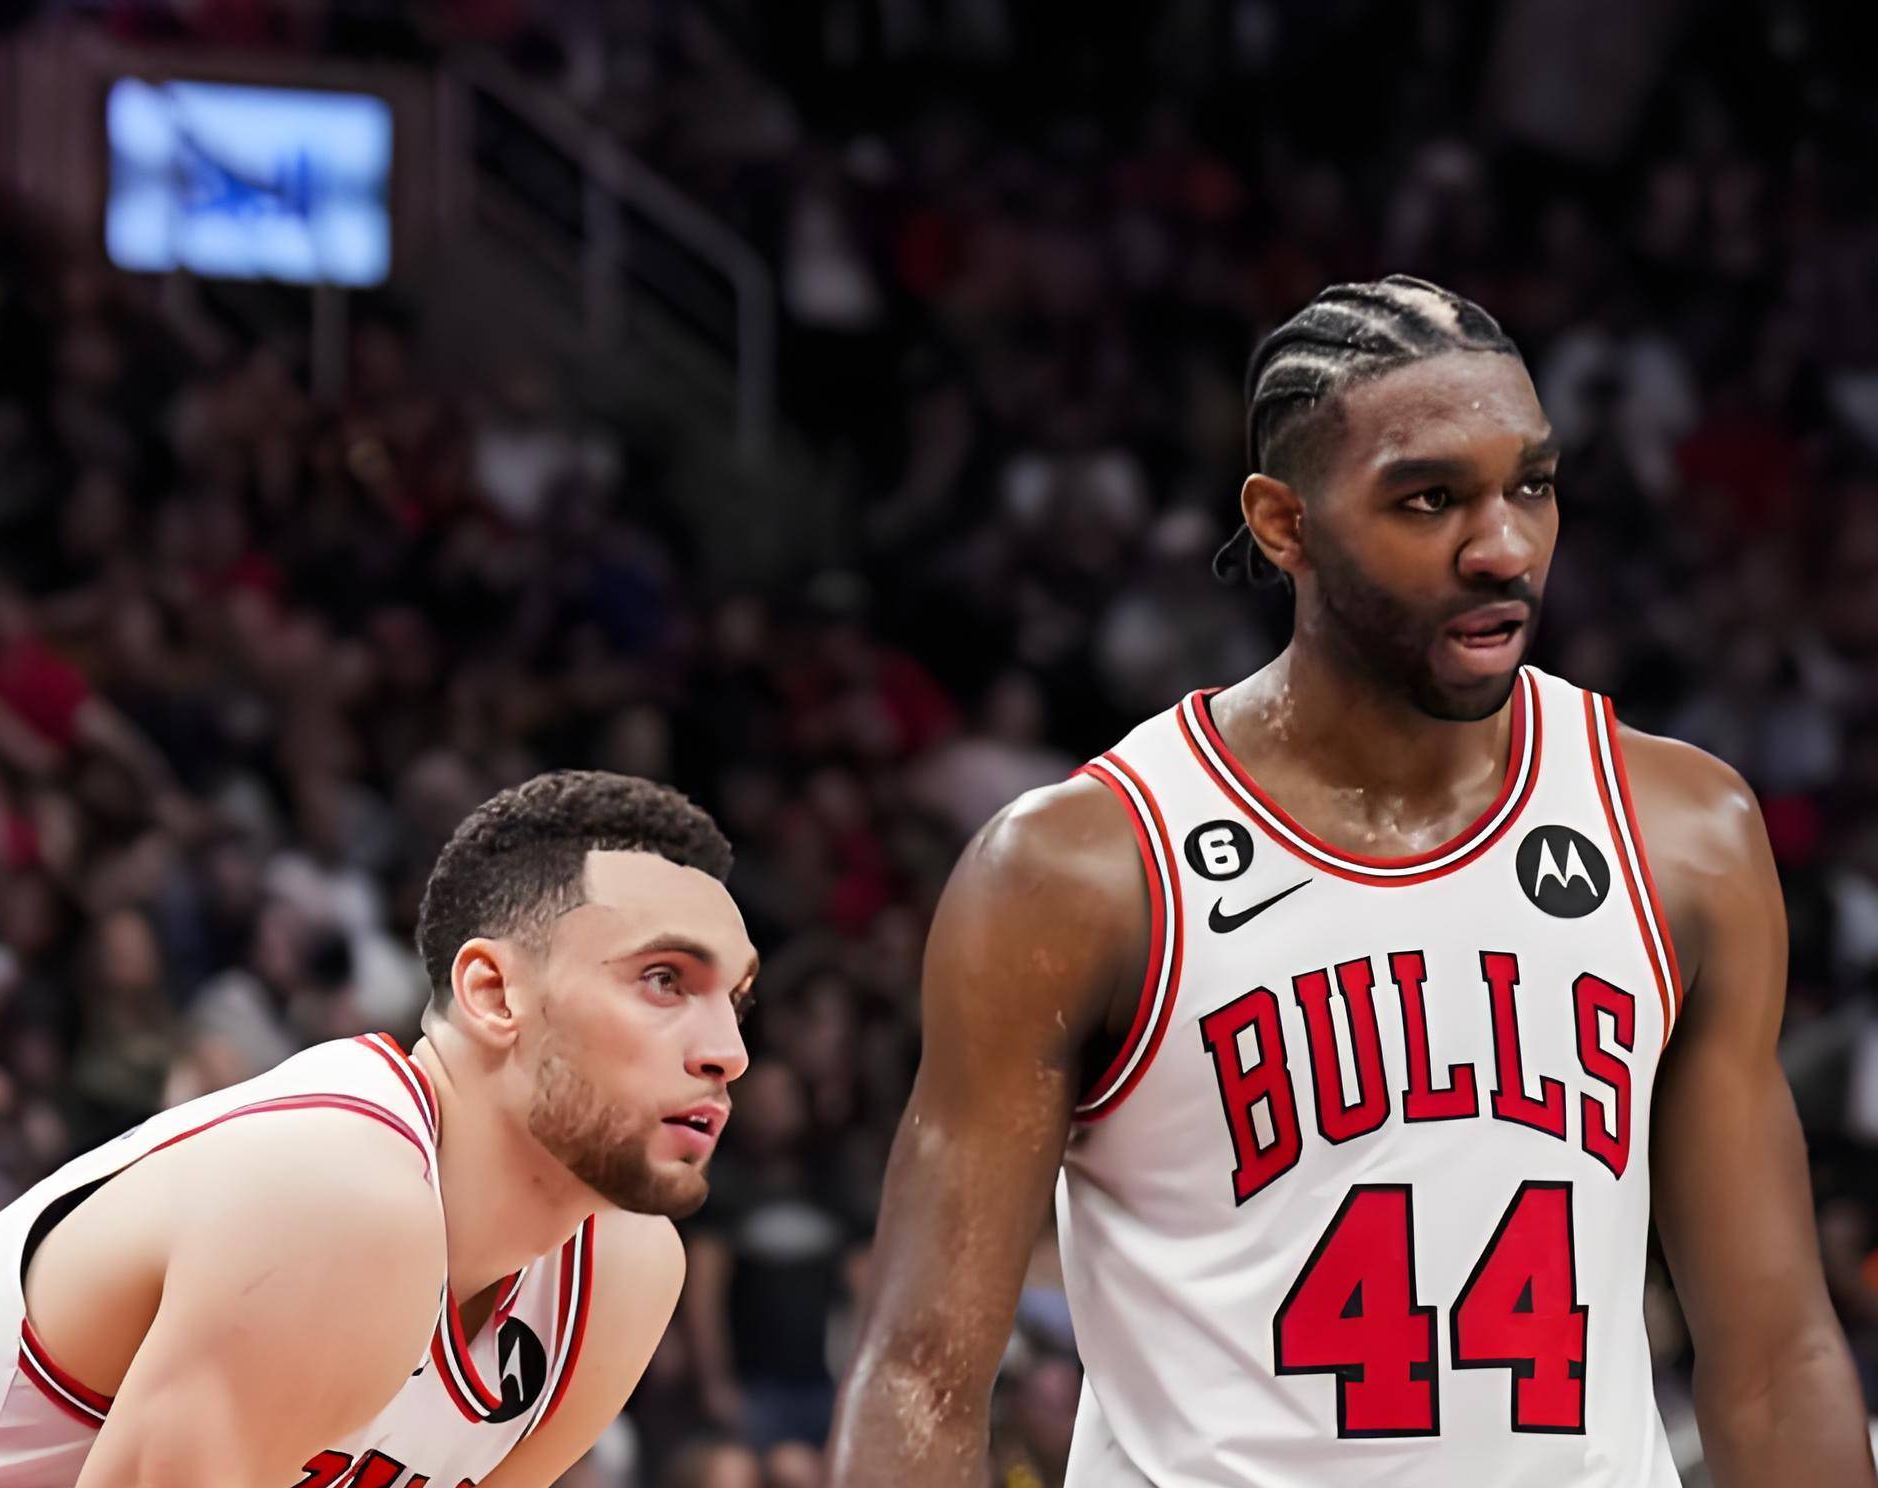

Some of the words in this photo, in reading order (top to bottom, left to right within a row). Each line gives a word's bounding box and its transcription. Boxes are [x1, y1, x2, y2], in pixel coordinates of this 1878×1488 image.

[1198, 827, 1241, 876] 6
[1198, 949, 1636, 1207] BULLS
[1273, 1180, 1590, 1440] 44
